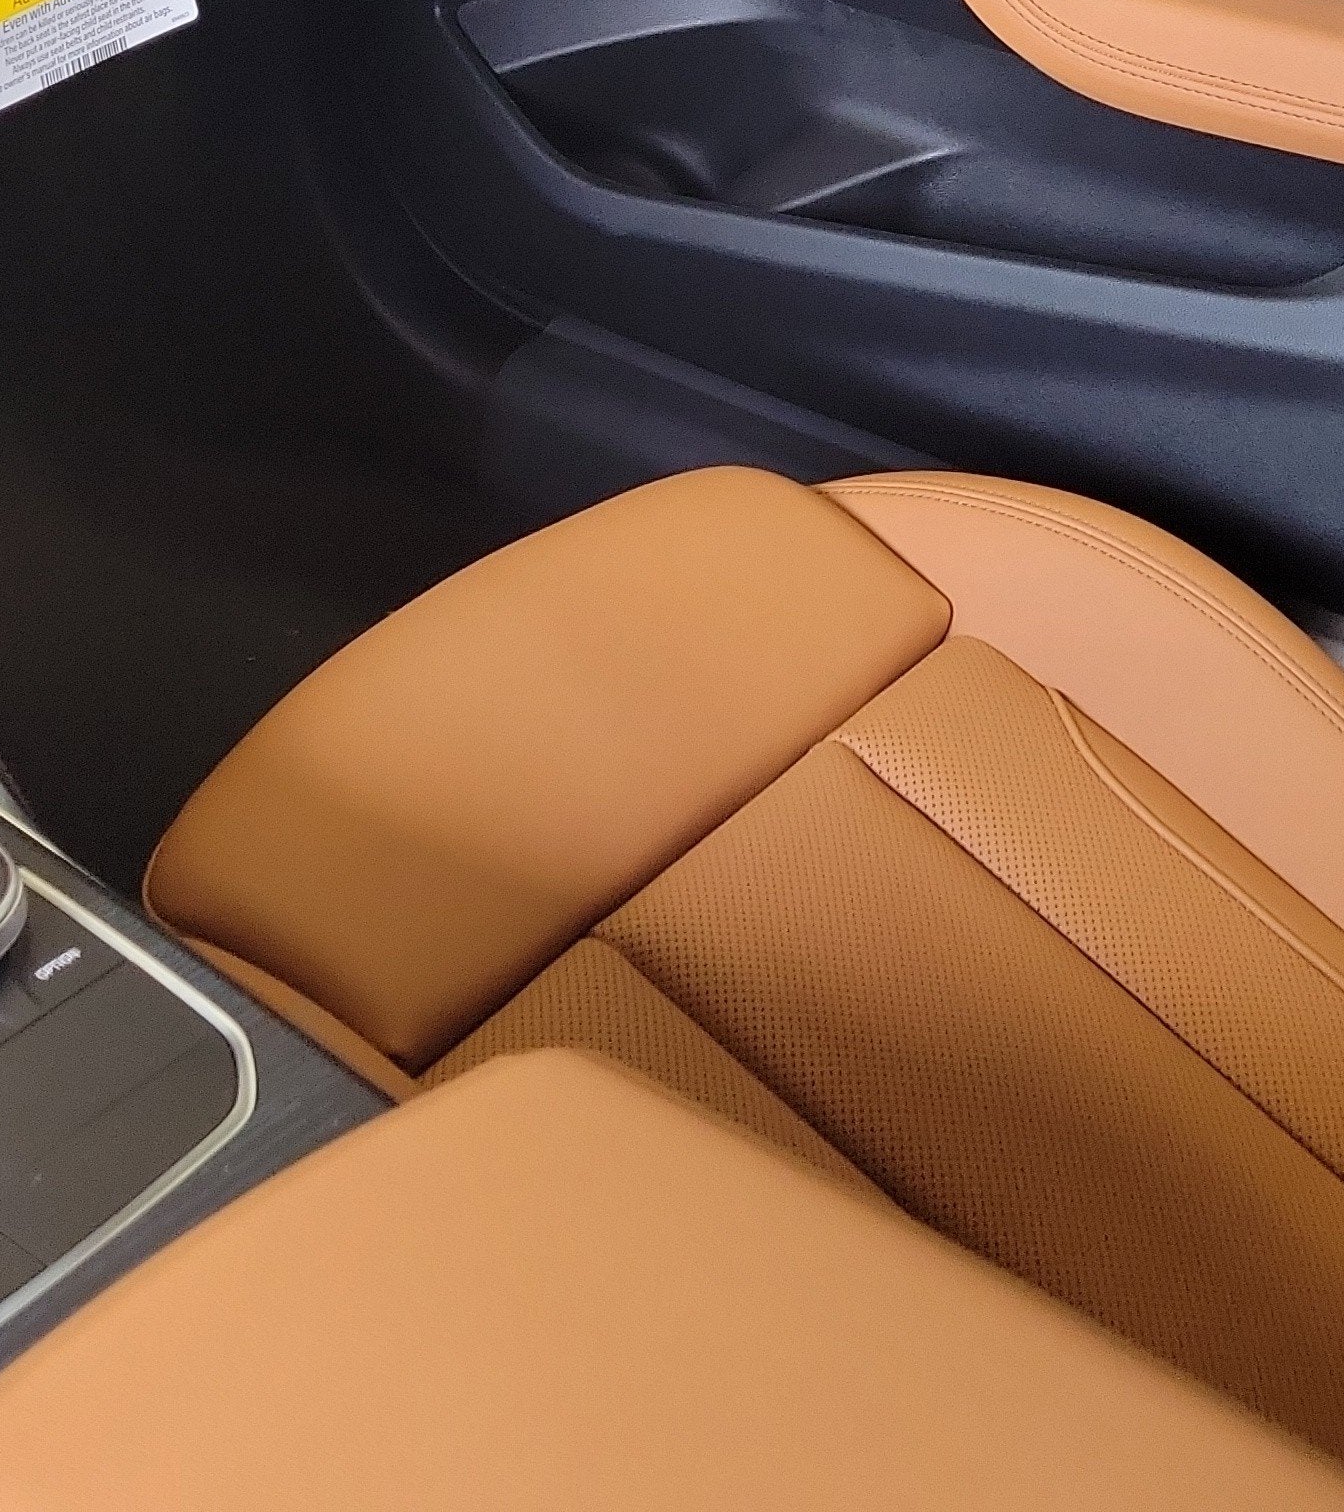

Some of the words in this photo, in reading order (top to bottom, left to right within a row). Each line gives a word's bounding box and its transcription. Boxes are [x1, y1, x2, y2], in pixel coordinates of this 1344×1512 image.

[2, 13, 28, 34] Even
[29, 1, 52, 21] with
[33, 946, 82, 981] OPTION
